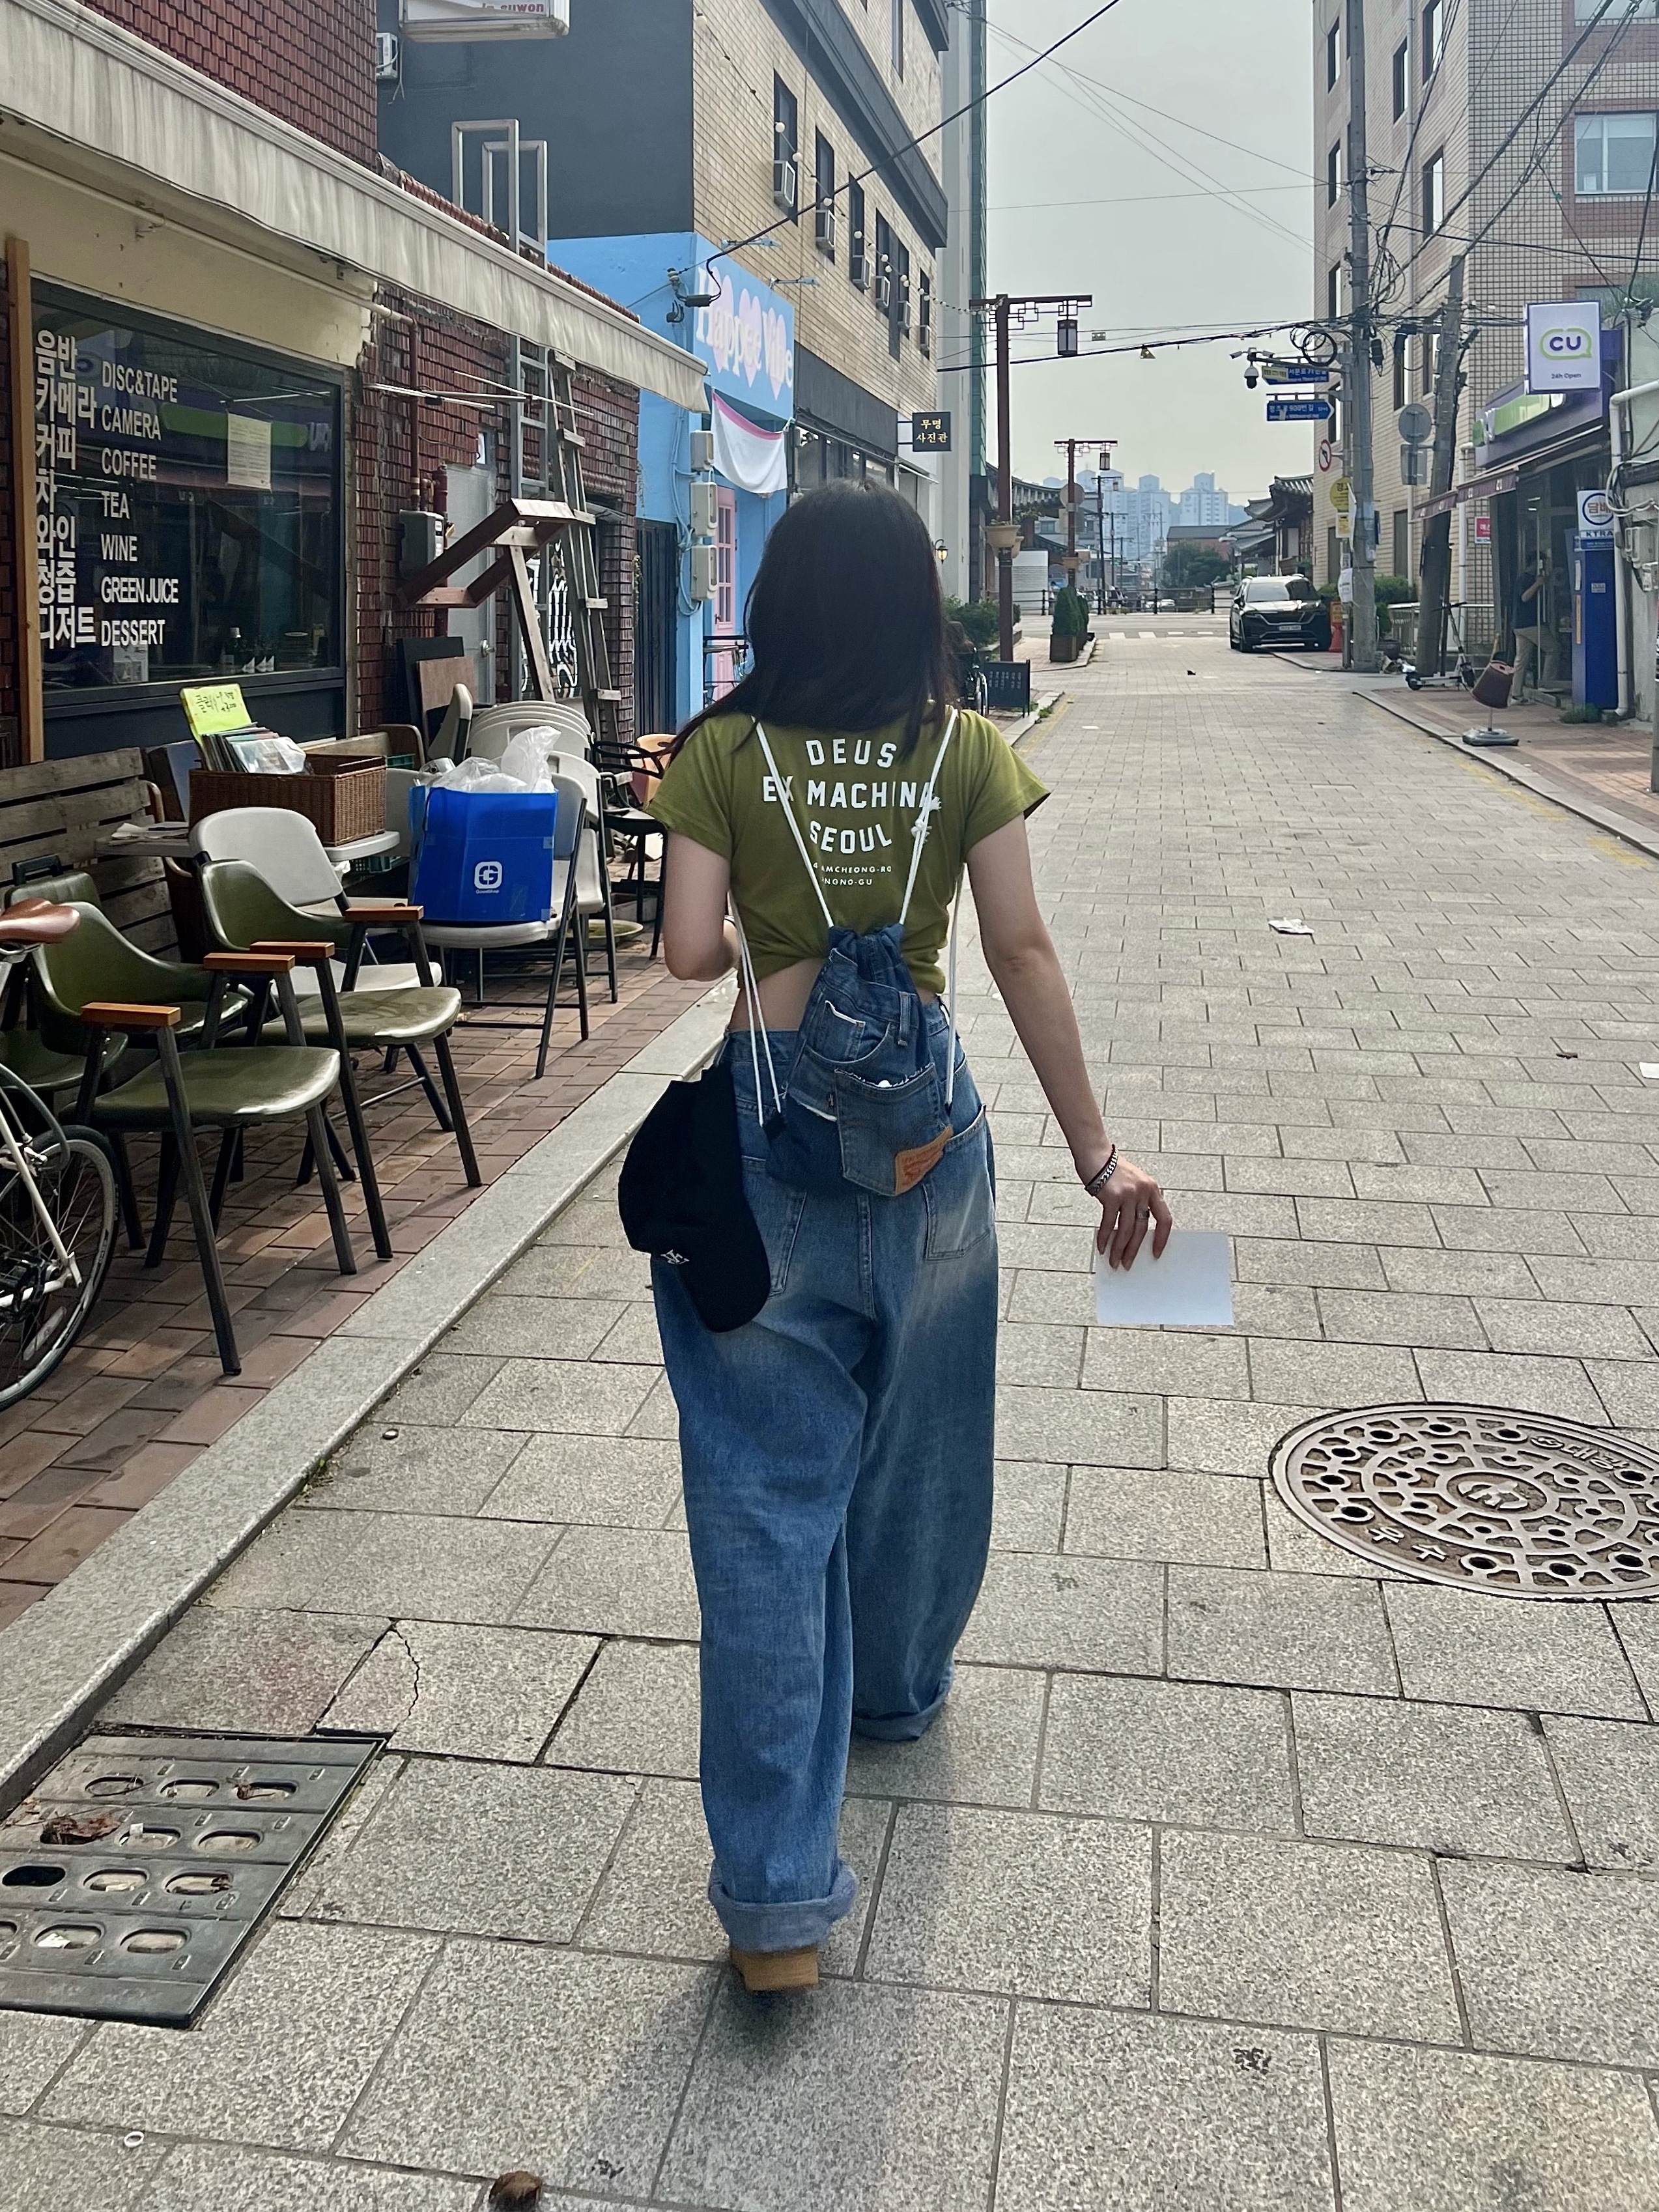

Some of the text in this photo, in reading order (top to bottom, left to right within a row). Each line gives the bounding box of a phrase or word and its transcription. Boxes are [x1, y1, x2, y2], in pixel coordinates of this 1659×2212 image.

[35, 330, 78, 380] 음반
[1550, 335, 1581, 351] CU
[102, 361, 178, 403] DISC&TAPE
[35, 377, 98, 429] 카메라
[102, 404, 162, 441] CAMERA
[915, 431, 948, 444] 사진관
[920, 418, 942, 430] 무명
[35, 423, 77, 470] 커피
[102, 447, 157, 481] COFFEE
[35, 468, 58, 513] 차
[101, 491, 130, 520] TEA
[36, 514, 76, 559] 와인
[100, 533, 138, 562] WINE
[37, 558, 77, 604] 청즙
[38, 604, 96, 649] 디저트
[101, 619, 166, 647] DESSERT
[806, 739, 898, 768] DEUS
[763, 776, 795, 802] EX
[810, 820, 892, 855] SEOUL
